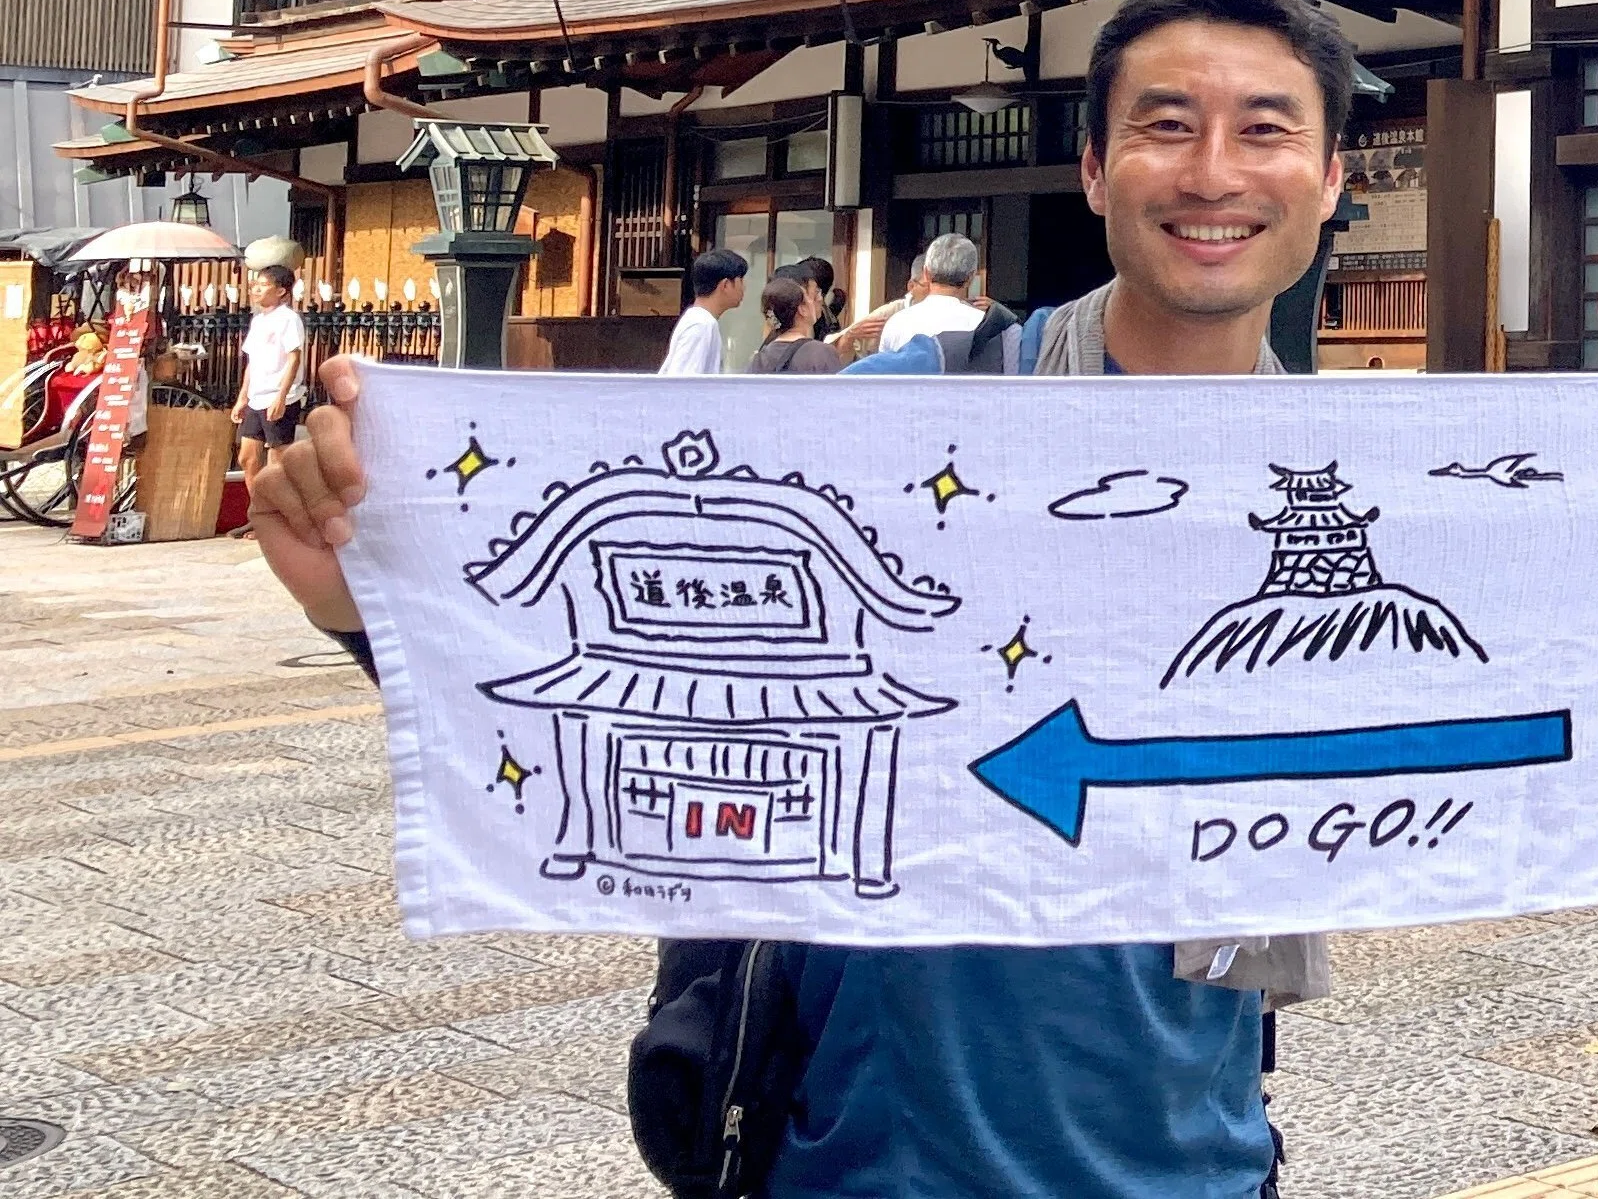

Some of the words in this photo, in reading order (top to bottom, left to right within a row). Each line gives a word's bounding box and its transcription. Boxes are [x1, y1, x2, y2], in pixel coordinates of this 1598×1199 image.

[1372, 128, 1424, 146] 道後温泉本館
[630, 569, 793, 609] 道後温泉
[685, 801, 757, 840] IN
